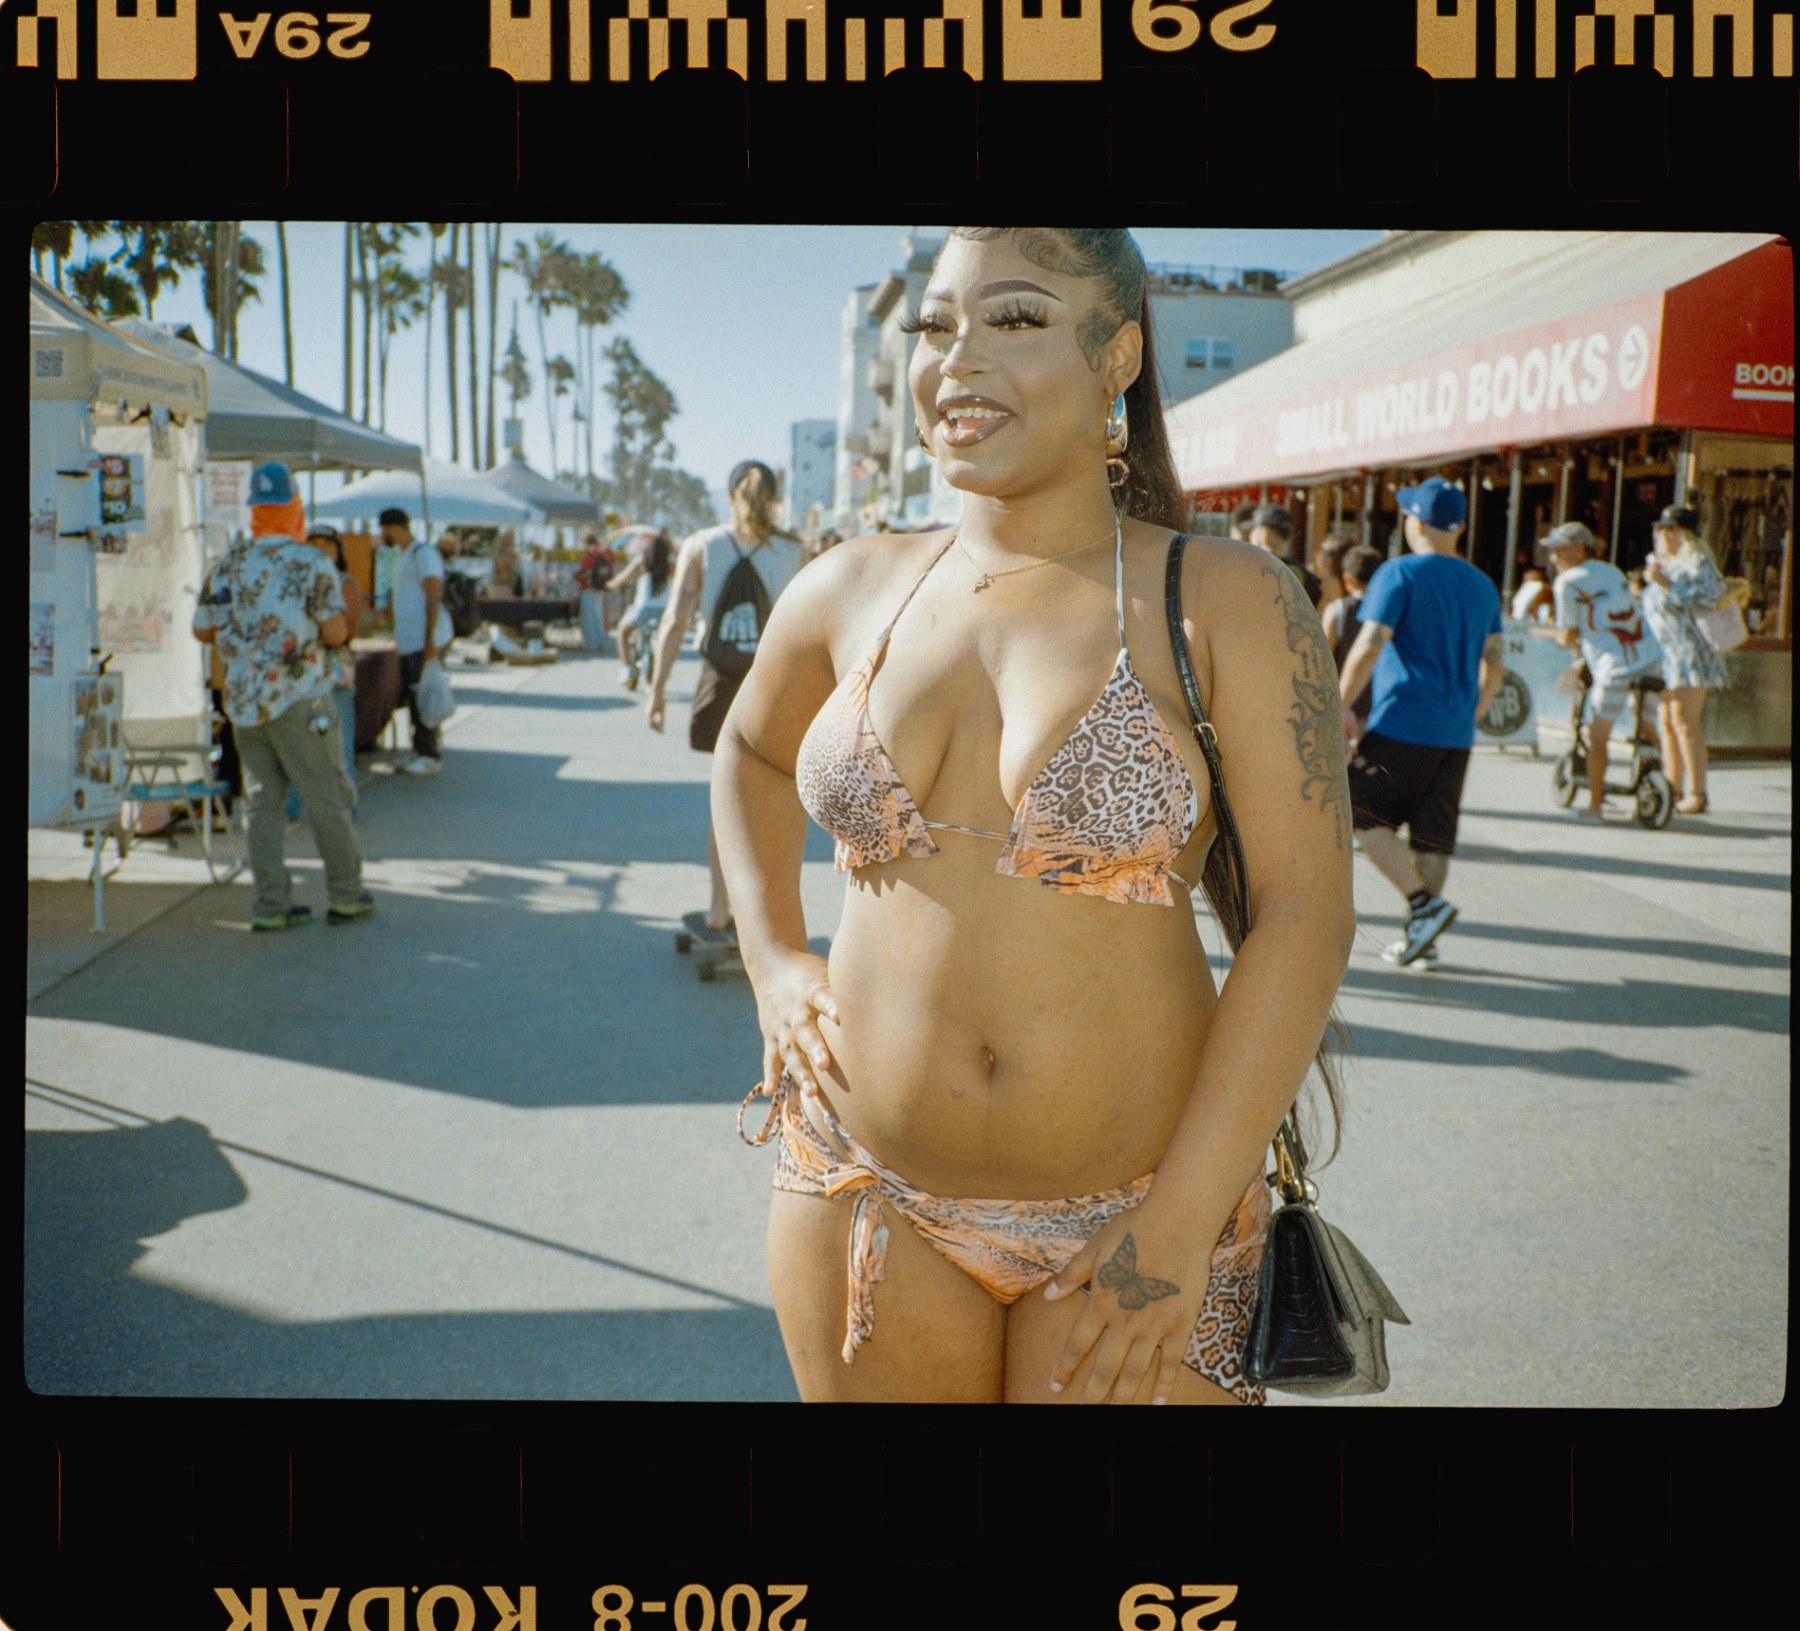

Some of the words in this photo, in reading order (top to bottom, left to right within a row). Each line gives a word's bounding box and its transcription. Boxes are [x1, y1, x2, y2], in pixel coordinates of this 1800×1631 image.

[219, 12, 371, 58] 29A
[1132, 0, 1276, 52] 29
[1276, 398, 1348, 459] SMALL
[1356, 369, 1458, 443] WORLD
[1465, 331, 1609, 424] BOOKS
[592, 1584, 808, 1631] 200-8
[1119, 1584, 1239, 1631] 29
